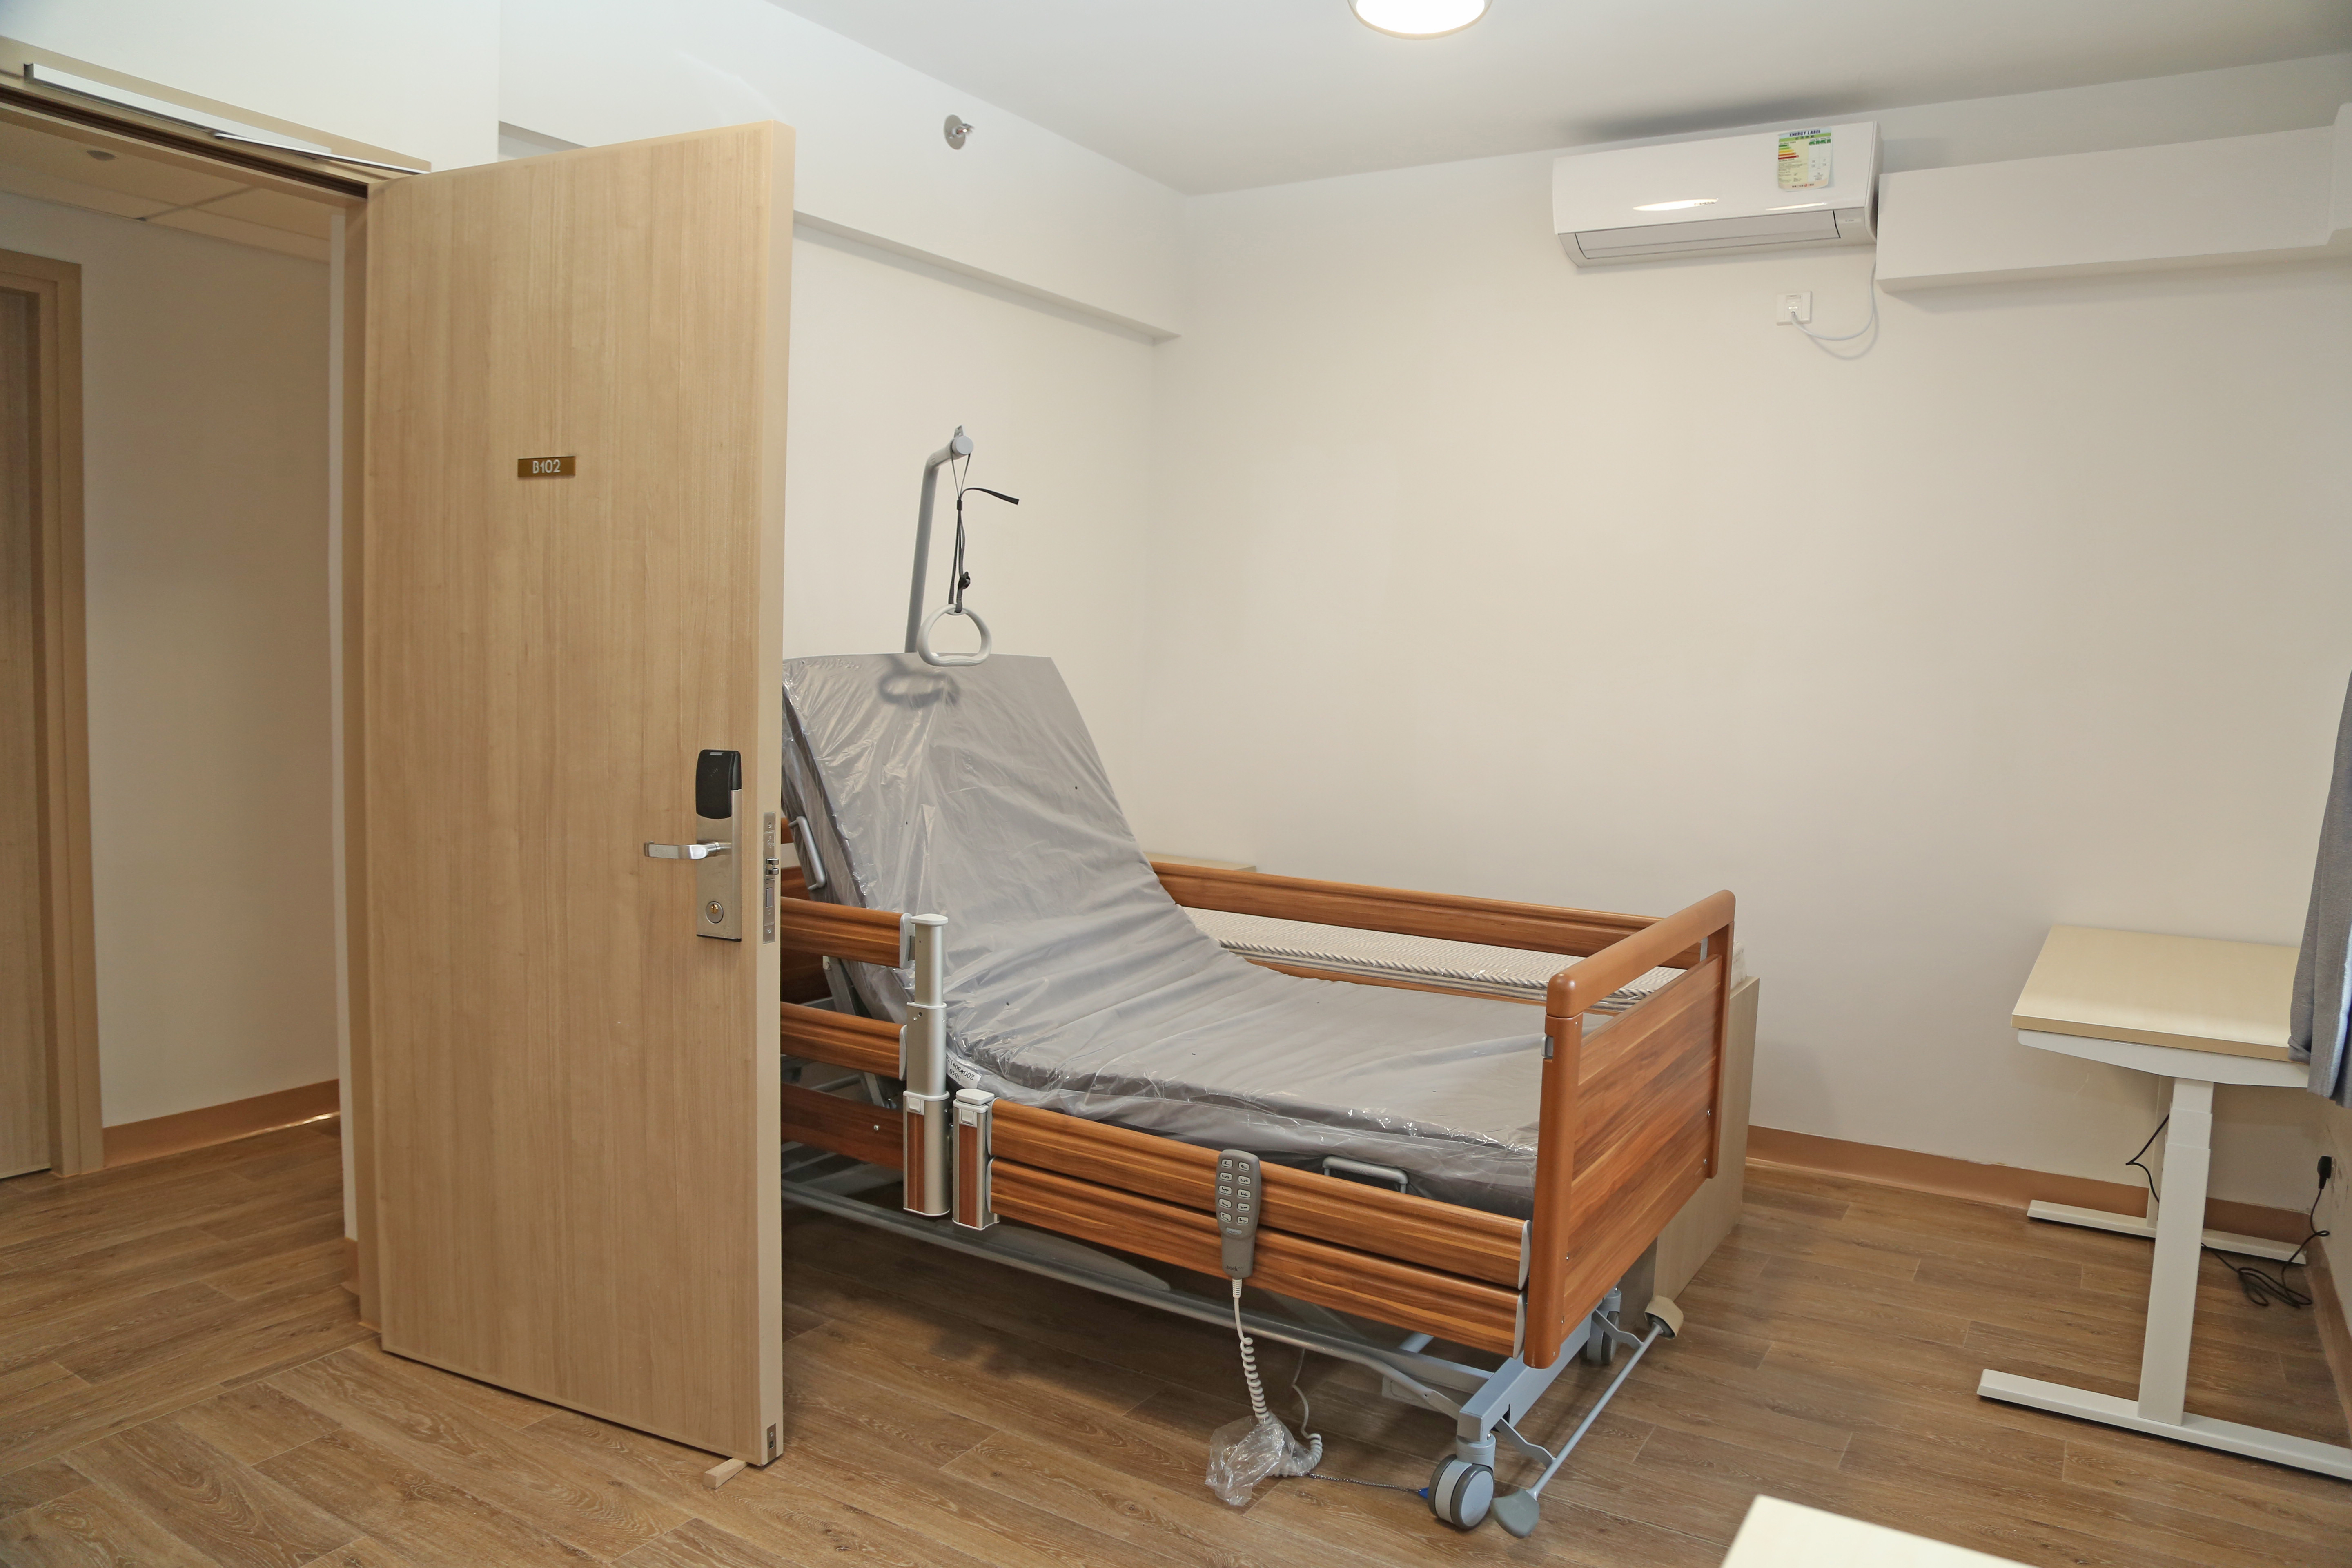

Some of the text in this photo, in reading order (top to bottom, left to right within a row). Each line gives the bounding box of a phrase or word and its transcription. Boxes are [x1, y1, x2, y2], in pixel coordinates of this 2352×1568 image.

[532, 459, 560, 474] B102
[946, 1054, 975, 1080] 2009013c
[949, 1069, 961, 1081] 3840
